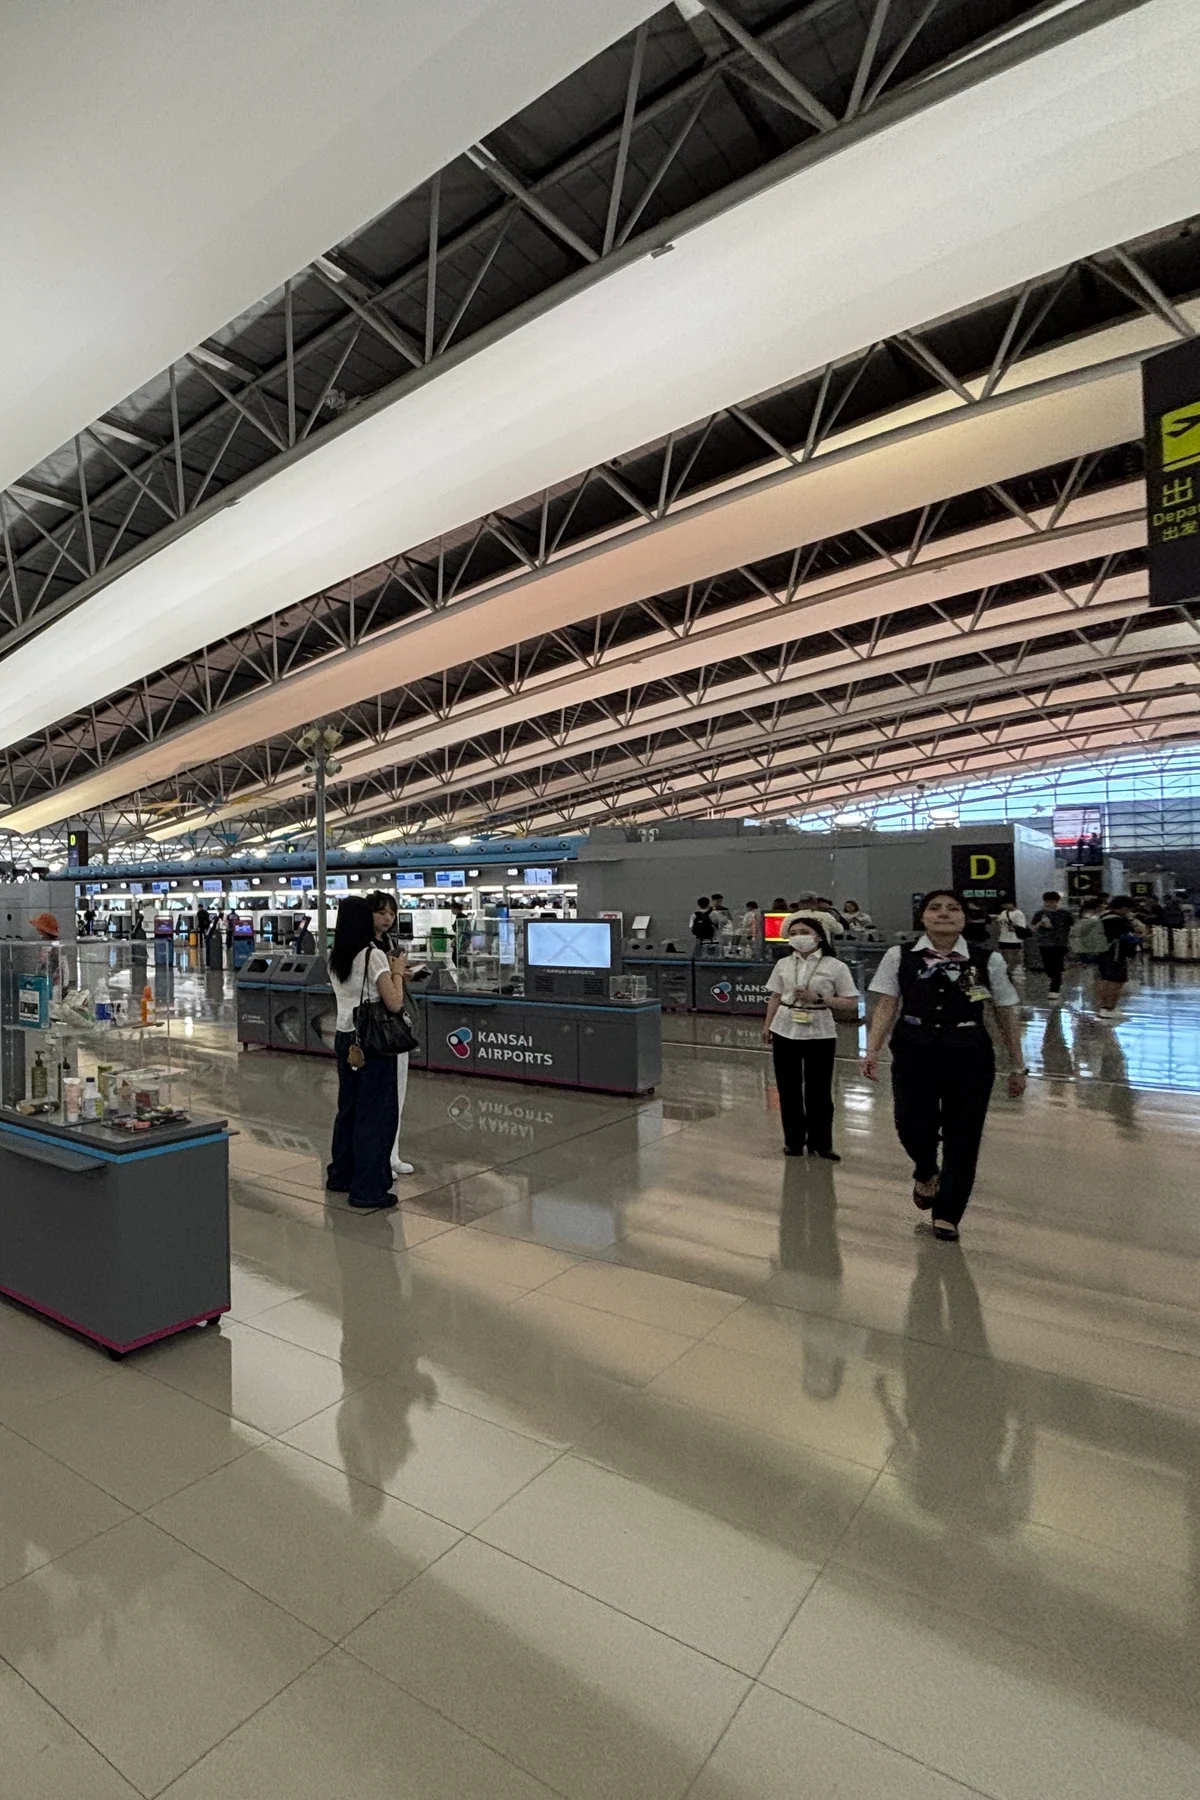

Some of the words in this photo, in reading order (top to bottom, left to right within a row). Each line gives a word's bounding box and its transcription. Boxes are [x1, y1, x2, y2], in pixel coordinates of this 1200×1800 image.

[1153, 504, 1200, 526] Depa
[70, 834, 76, 846] D
[969, 854, 996, 879] D
[1074, 874, 1091, 890] C
[1136, 883, 1148, 894] B
[735, 984, 771, 993] KANS
[735, 994, 771, 1004] AIRPO
[478, 1031, 533, 1047] KANSAI
[478, 1047, 553, 1066] AIRPORTS
